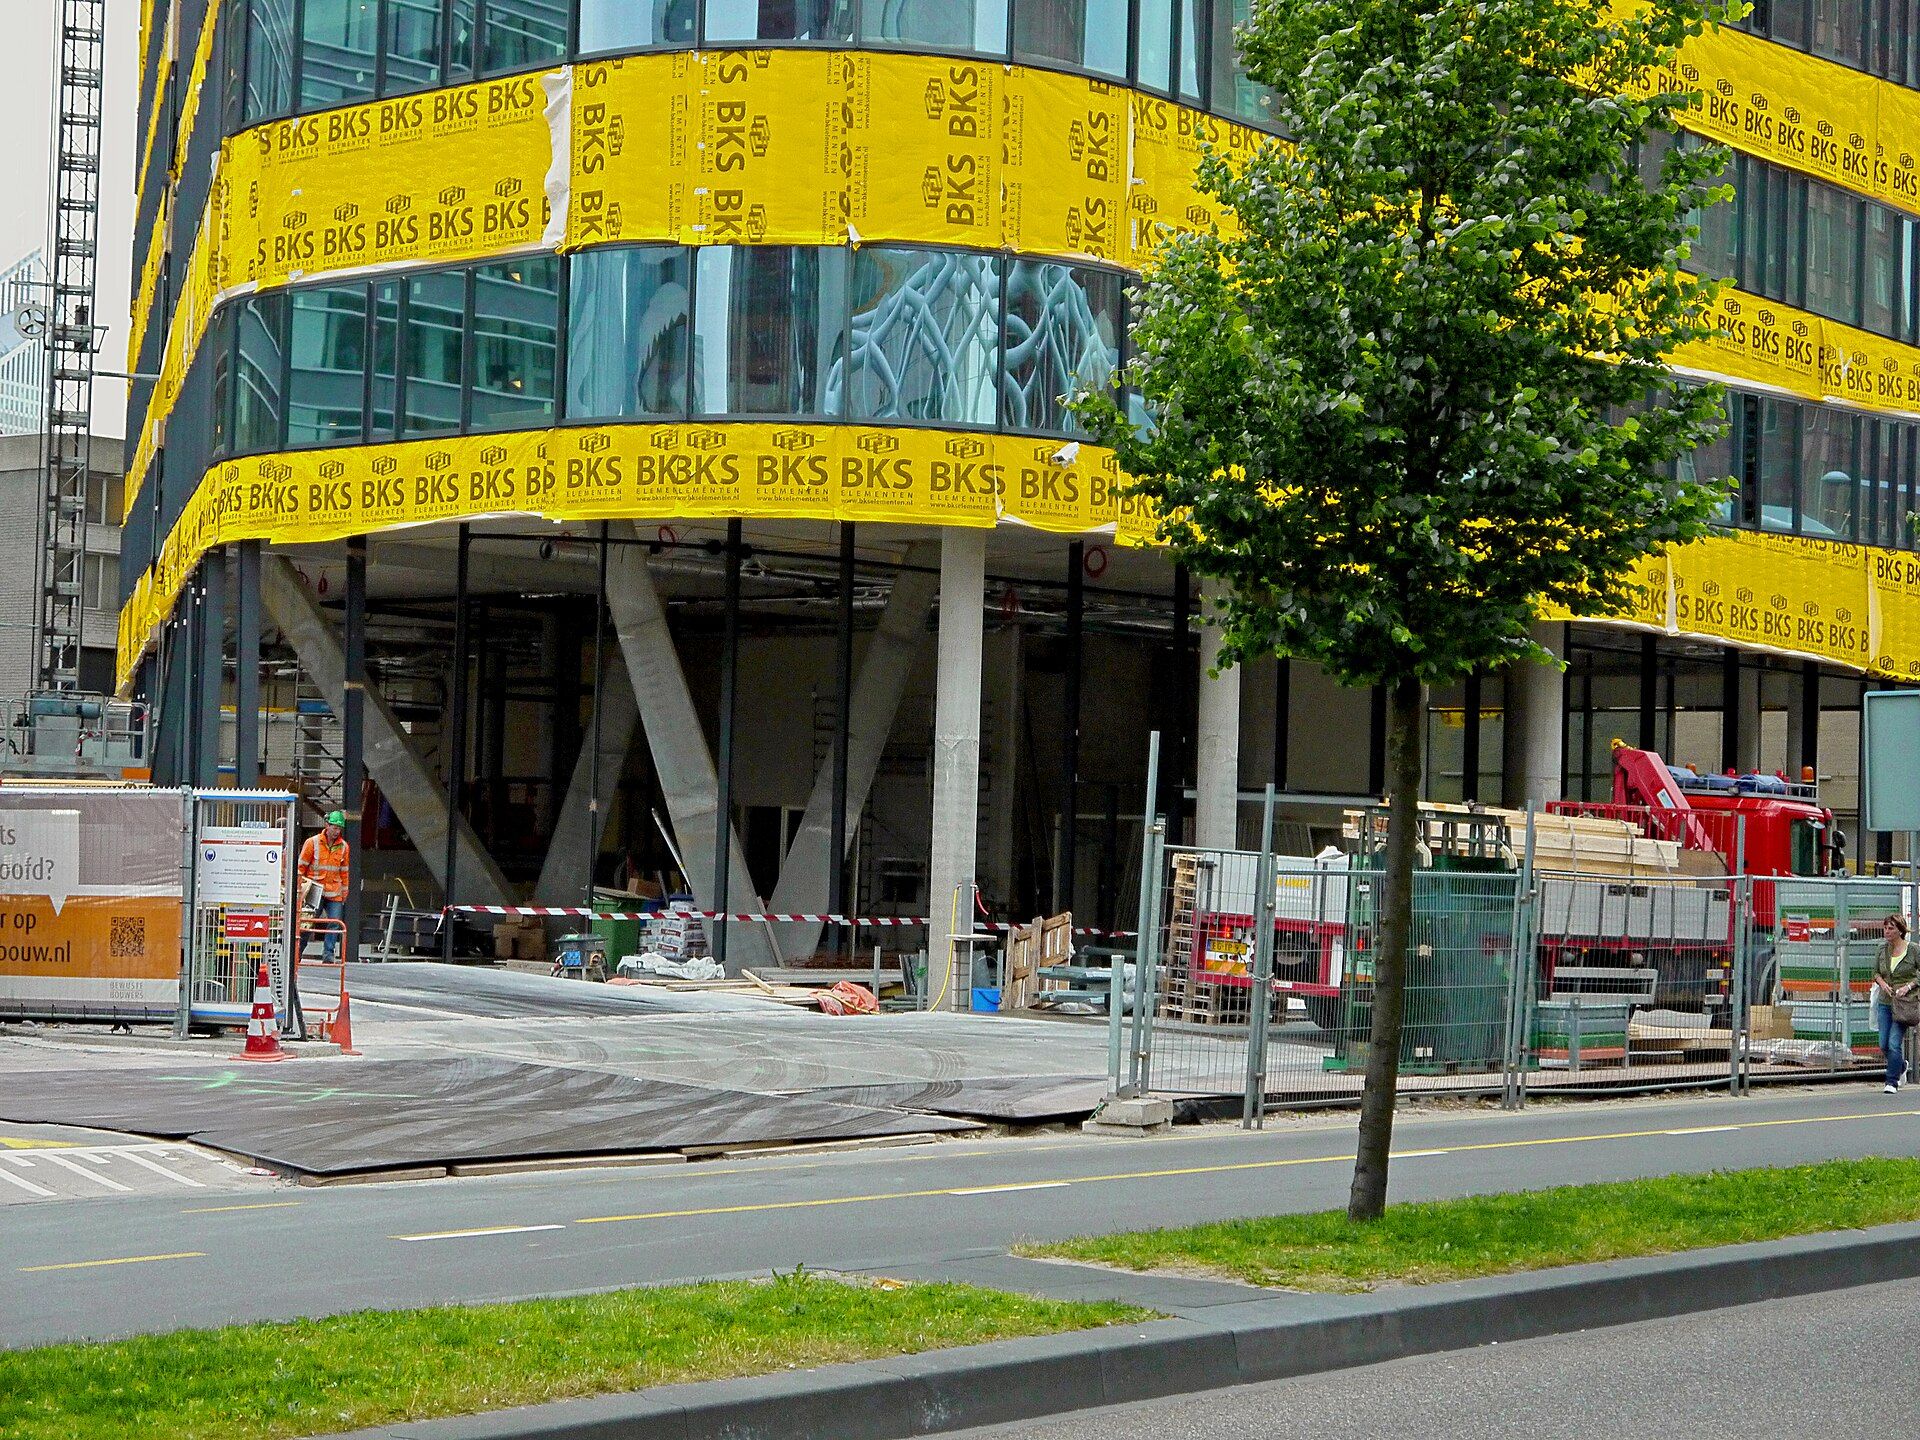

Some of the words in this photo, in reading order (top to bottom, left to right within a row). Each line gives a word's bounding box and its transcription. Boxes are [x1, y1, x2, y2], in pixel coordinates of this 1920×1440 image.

[279, 118, 319, 151] BKS
[328, 108, 371, 142] BKS
[380, 99, 423, 134] BKS
[433, 88, 479, 124] BKS
[488, 77, 534, 114] BKS
[582, 102, 606, 174] BKS
[716, 100, 747, 173] BKS
[831, 101, 839, 174] ELEMENTEN
[948, 66, 979, 138] BKS
[979, 67, 987, 139] ELEMENTEN
[1087, 109, 1110, 182] BKS
[1710, 96, 1739, 126] BKS
[1745, 111, 1773, 141] BKS
[1778, 121, 1805, 153] BKS
[1811, 135, 1838, 166] BKS
[1842, 148, 1868, 178] BKS
[1893, 167, 1918, 196] BKS
[945, 153, 976, 226] BKS
[274, 230, 315, 263] BKS
[324, 222, 366, 256] BKS
[375, 214, 419, 249] BKS
[429, 206, 474, 241] BKS
[483, 197, 530, 234] BKS
[1752, 325, 1780, 355] BKS
[1785, 335, 1813, 365] BKS
[1847, 367, 1873, 393] BKS
[1878, 373, 1903, 399] BKS
[308, 481, 352, 512] BKS
[361, 477, 405, 509] BKS
[415, 472, 460, 506] BKS
[469, 466, 516, 501] BKS
[566, 455, 622, 489] BKS
[675, 453, 740, 486] BKS
[757, 454, 829, 486] BKS
[841, 456, 913, 490] BKS
[1020, 468, 1080, 503] BKS
[566, 487, 622, 498] ELEMENTEN
[757, 487, 829, 496] ELEMENTEN
[841, 490, 913, 499] ELEMENTEN
[1020, 500, 1080, 512] ELEMENTEN
[1877, 556, 1902, 582] BKS
[1695, 597, 1724, 625] BKS
[1730, 604, 1759, 632] BKS
[1763, 611, 1791, 638] BKS
[1797, 617, 1824, 644] BKS
[1829, 624, 1855, 650] BKS
[14, 913, 36, 935] op
[109, 982, 144, 990] BEWUSTE
[109, 991, 144, 1000] BOUWERS
